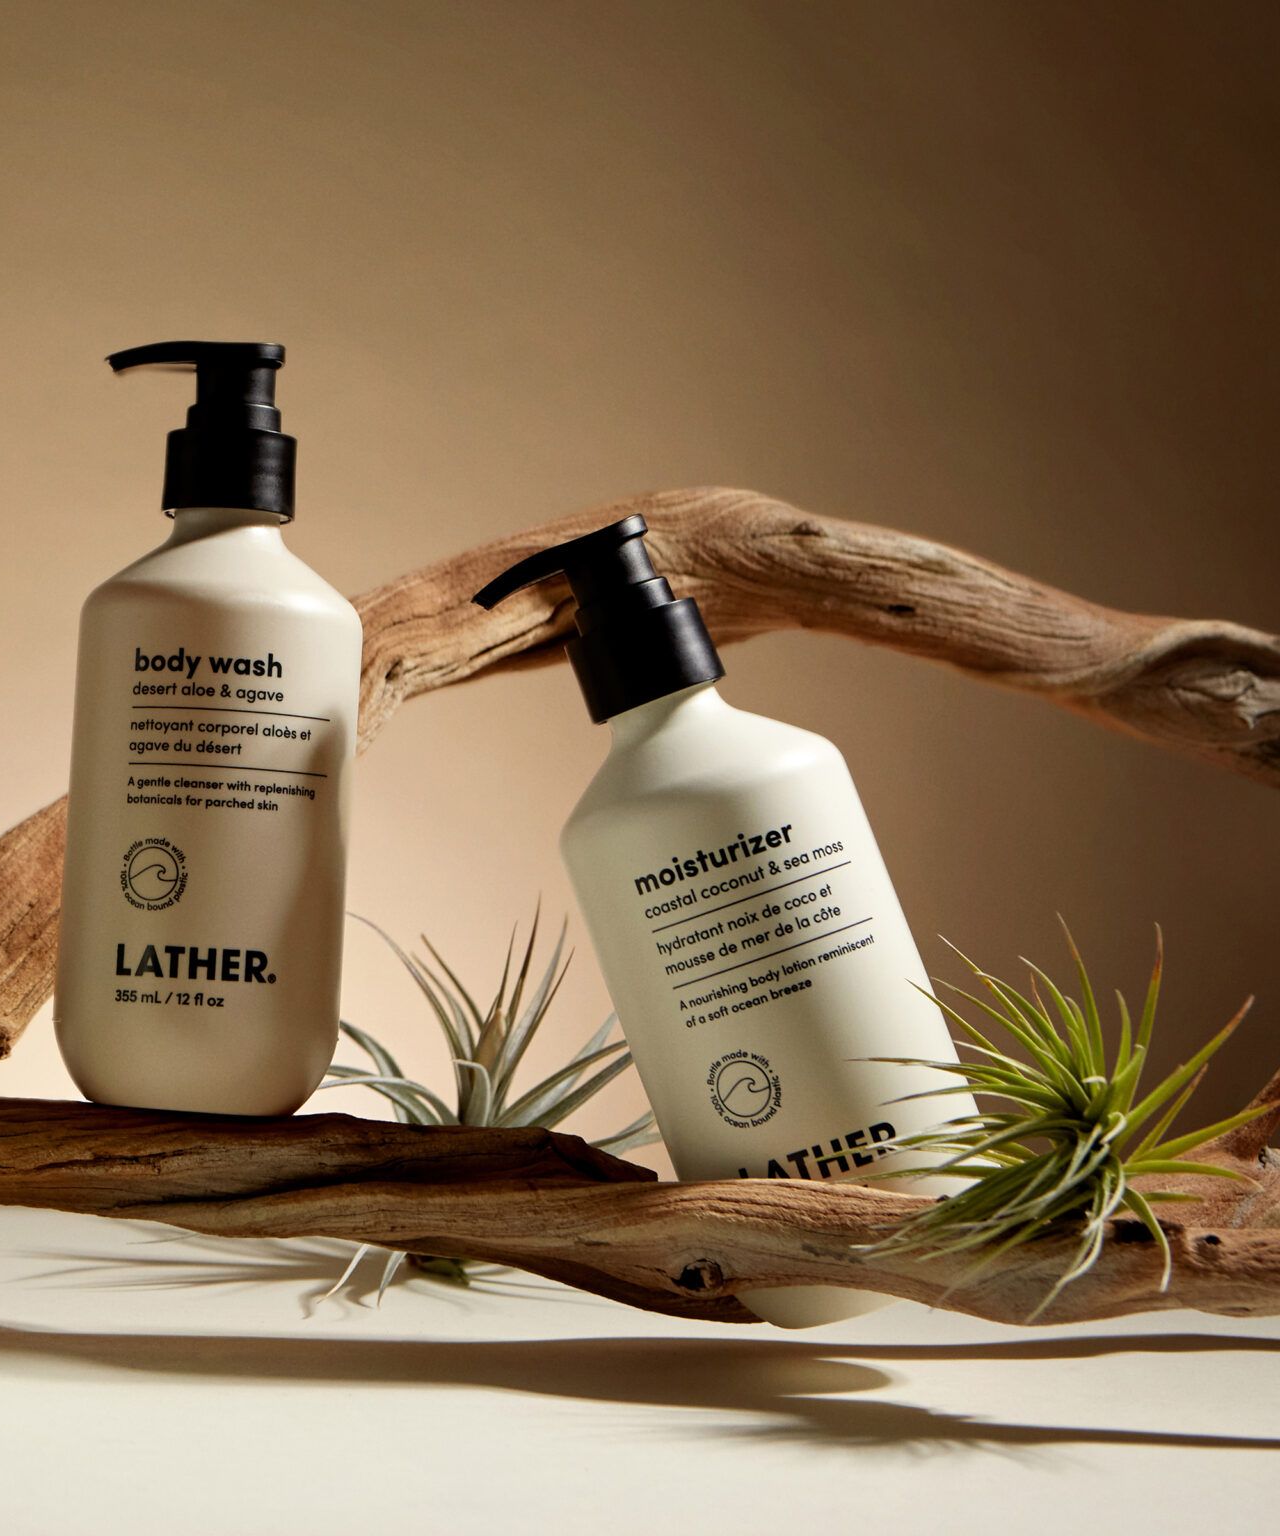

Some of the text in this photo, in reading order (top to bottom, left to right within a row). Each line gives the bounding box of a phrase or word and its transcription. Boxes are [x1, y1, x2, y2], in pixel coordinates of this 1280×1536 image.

[135, 647, 282, 679] body wash
[133, 681, 284, 703] desert aloe & agave
[129, 739, 242, 755] agave du désert
[131, 719, 311, 741] nettoyant corporel aloès et
[127, 793, 278, 811] botanicals for parched skin
[128, 776, 315, 800] A gentle cleanser with replenishing
[123, 837, 186, 864] Bottle made with
[634, 824, 792, 895] moisturizer
[120, 870, 188, 911] 100% ocean bound plastic
[645, 841, 843, 919] coastal coconut & sea moss
[656, 884, 832, 956] hydratant noix de coco et
[665, 907, 841, 975] mousse de mer de la côte
[680, 934, 874, 1011] A nourishing body lotion reminiscent
[115, 989, 224, 1007] 355 mL / 12 fl oz
[686, 979, 812, 1028] of a soft ocean breeze
[707, 1049, 769, 1085] Bottle made with
[710, 1075, 782, 1128] 100% ocean bound plastic
